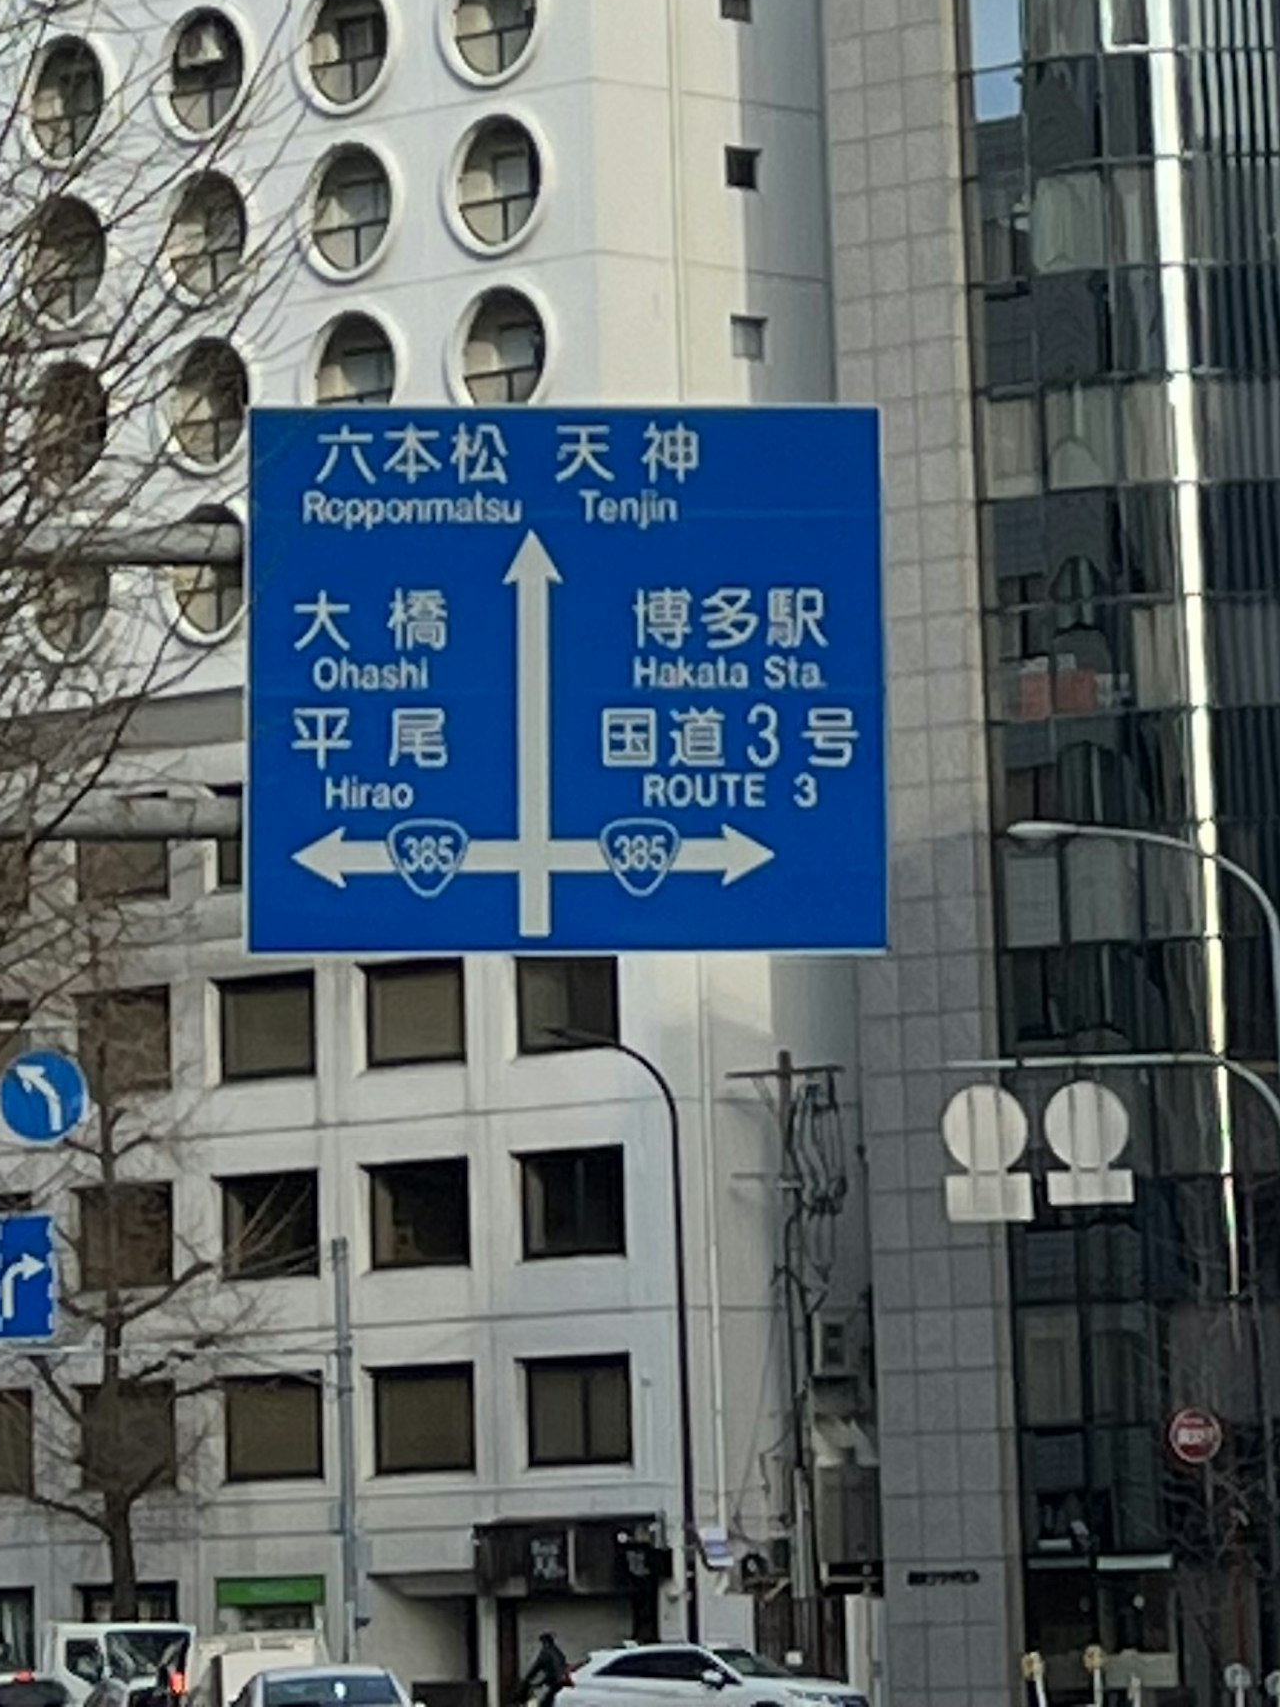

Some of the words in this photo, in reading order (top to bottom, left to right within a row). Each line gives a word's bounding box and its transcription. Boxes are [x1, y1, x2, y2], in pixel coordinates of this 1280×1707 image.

[316, 423, 508, 485] 六本松
[556, 421, 700, 484] 天神
[302, 490, 523, 531] Ropponmatsu
[579, 489, 679, 527] Tenjin
[293, 587, 449, 651] 大橋
[632, 586, 828, 650] 博多駅
[313, 657, 429, 691] Ohashi
[633, 656, 749, 689] Hakata
[764, 656, 825, 689] Sta.
[291, 706, 449, 770] 平尾
[601, 703, 859, 769] 国道3号
[325, 776, 415, 810] Hirao
[643, 773, 766, 808] ROUTE
[793, 773, 818, 808] 3
[399, 836, 455, 874] 385
[612, 836, 668, 874] 385
